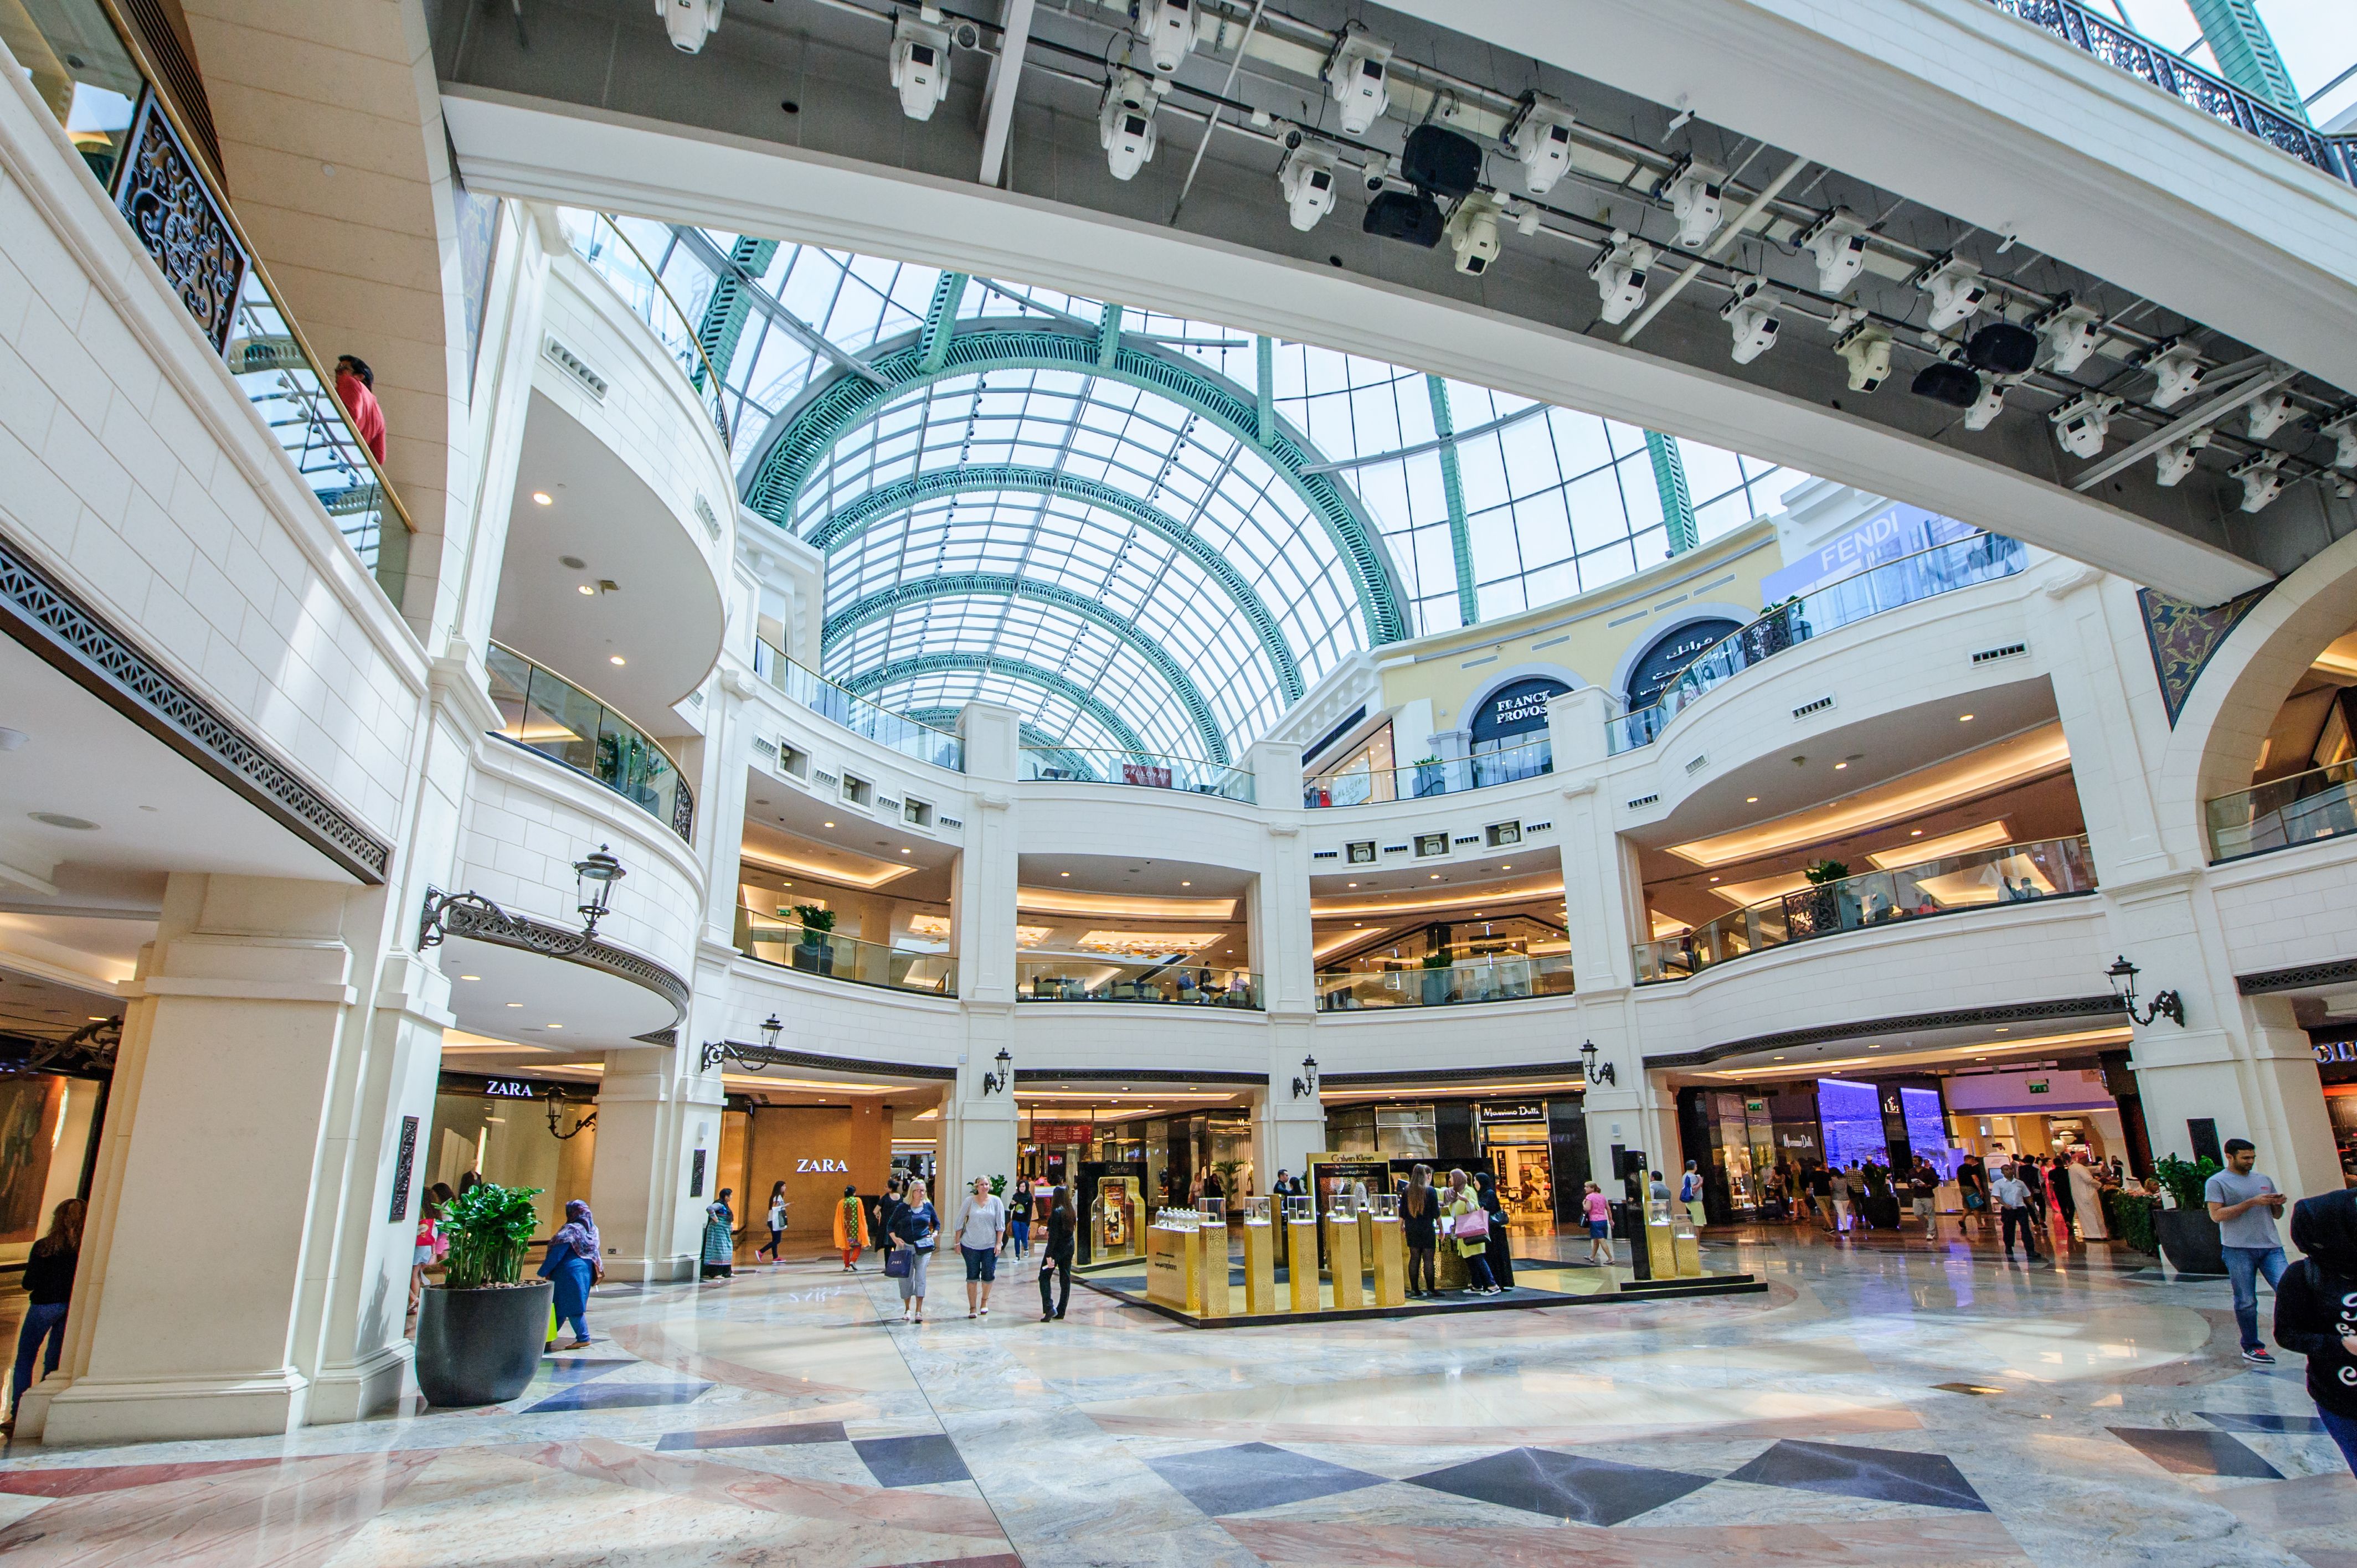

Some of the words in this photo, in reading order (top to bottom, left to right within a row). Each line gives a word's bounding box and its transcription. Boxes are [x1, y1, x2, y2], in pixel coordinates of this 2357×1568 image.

[1820, 510, 1900, 572] FENDI
[1496, 690, 1551, 712] FRANCK
[1124, 768, 1169, 780] DALLOYAU
[1332, 775, 1367, 802] DALLOYAU
[486, 1081, 533, 1097] ZARA
[1483, 1108, 1518, 1117] Massimo
[1519, 1106, 1540, 1116] Dutti
[796, 1159, 848, 1172] ZARA
